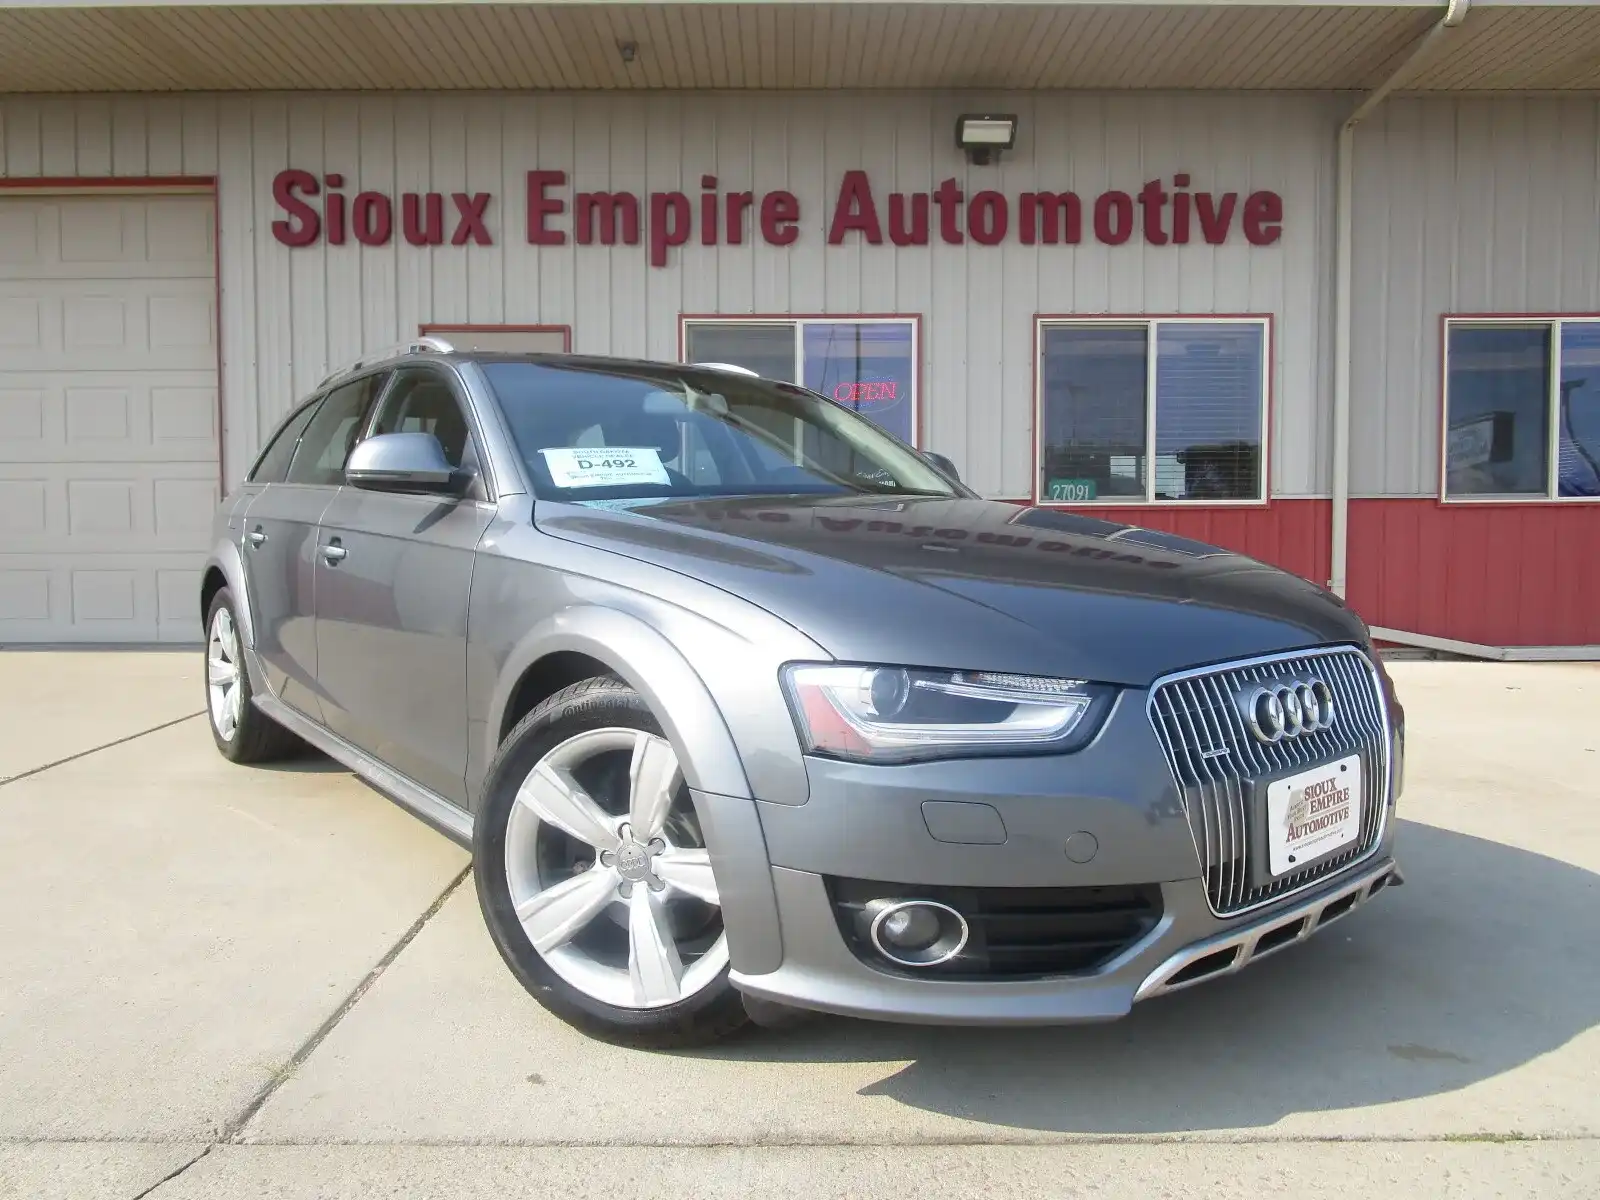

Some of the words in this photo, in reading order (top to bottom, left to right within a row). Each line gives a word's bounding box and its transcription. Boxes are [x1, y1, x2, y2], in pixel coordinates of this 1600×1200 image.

[272, 169, 493, 247] Sioux
[527, 170, 800, 268] Empire
[828, 170, 1284, 246] Automotive
[834, 382, 897, 401] OPEN
[577, 459, 638, 470] D-492
[1052, 484, 1090, 501] 27091
[1304, 777, 1337, 801] SIOUX
[1309, 787, 1349, 814] EMPIRE
[1285, 806, 1350, 843] AUTOMOTIVE
